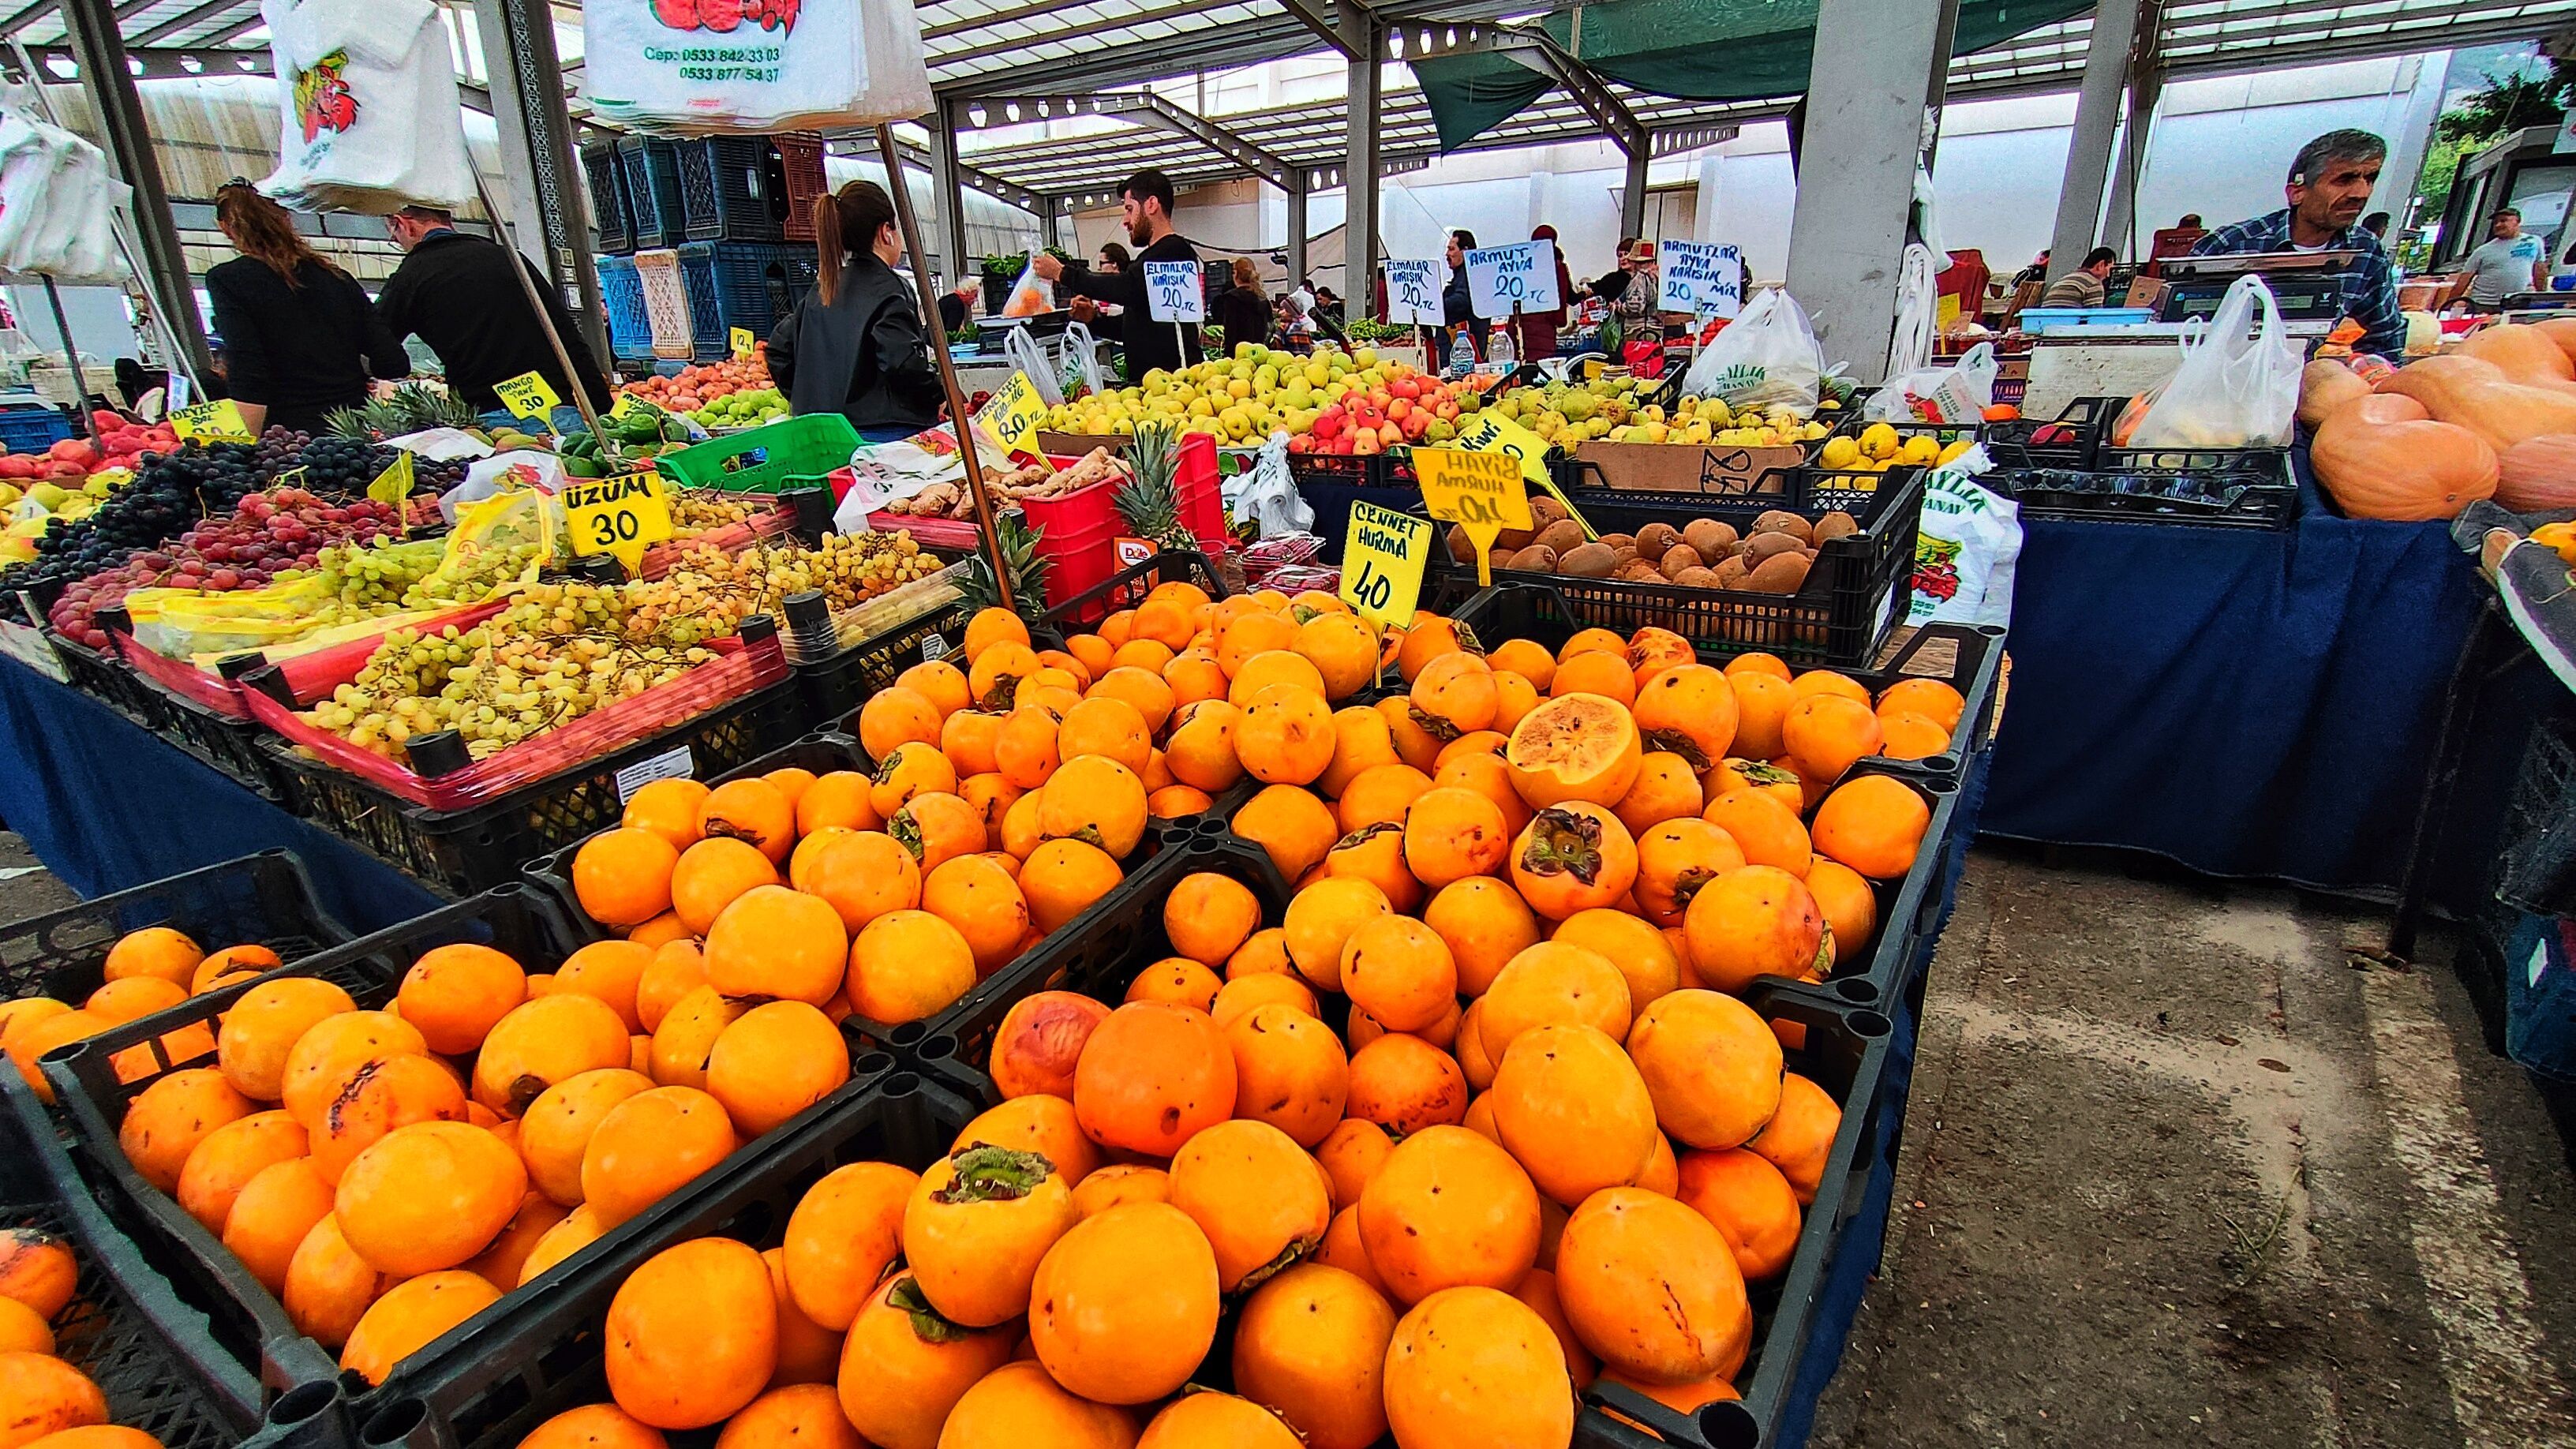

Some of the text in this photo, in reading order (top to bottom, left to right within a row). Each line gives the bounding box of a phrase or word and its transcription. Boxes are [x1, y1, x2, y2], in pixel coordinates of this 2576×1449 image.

[682, 49, 715, 62] 0533
[719, 50, 744, 62] 842
[749, 50, 765, 62] 33
[766, 48, 780, 62] 03
[680, 67, 713, 80] 0533
[717, 67, 741, 80] 877
[766, 68, 779, 82] 37
[1470, 247, 1529, 267] ARMUT
[1663, 240, 1738, 263] ARMUTLAR
[1147, 262, 1197, 276] ELMALAR
[1386, 260, 1432, 275] ELMALAR
[1499, 257, 1533, 273] AYVA
[1679, 253, 1710, 270] AYVA
[1665, 281, 1691, 300] 20
[1702, 302, 1719, 313] TL
[496, 376, 534, 395] MANGO
[519, 395, 545, 411] 30
[566, 475, 652, 509] ÜZÜM
[590, 510, 638, 545] 30
[1354, 503, 1421, 540] CENNET
[1357, 526, 1407, 560] HURMA
[1353, 560, 1391, 610] 40
